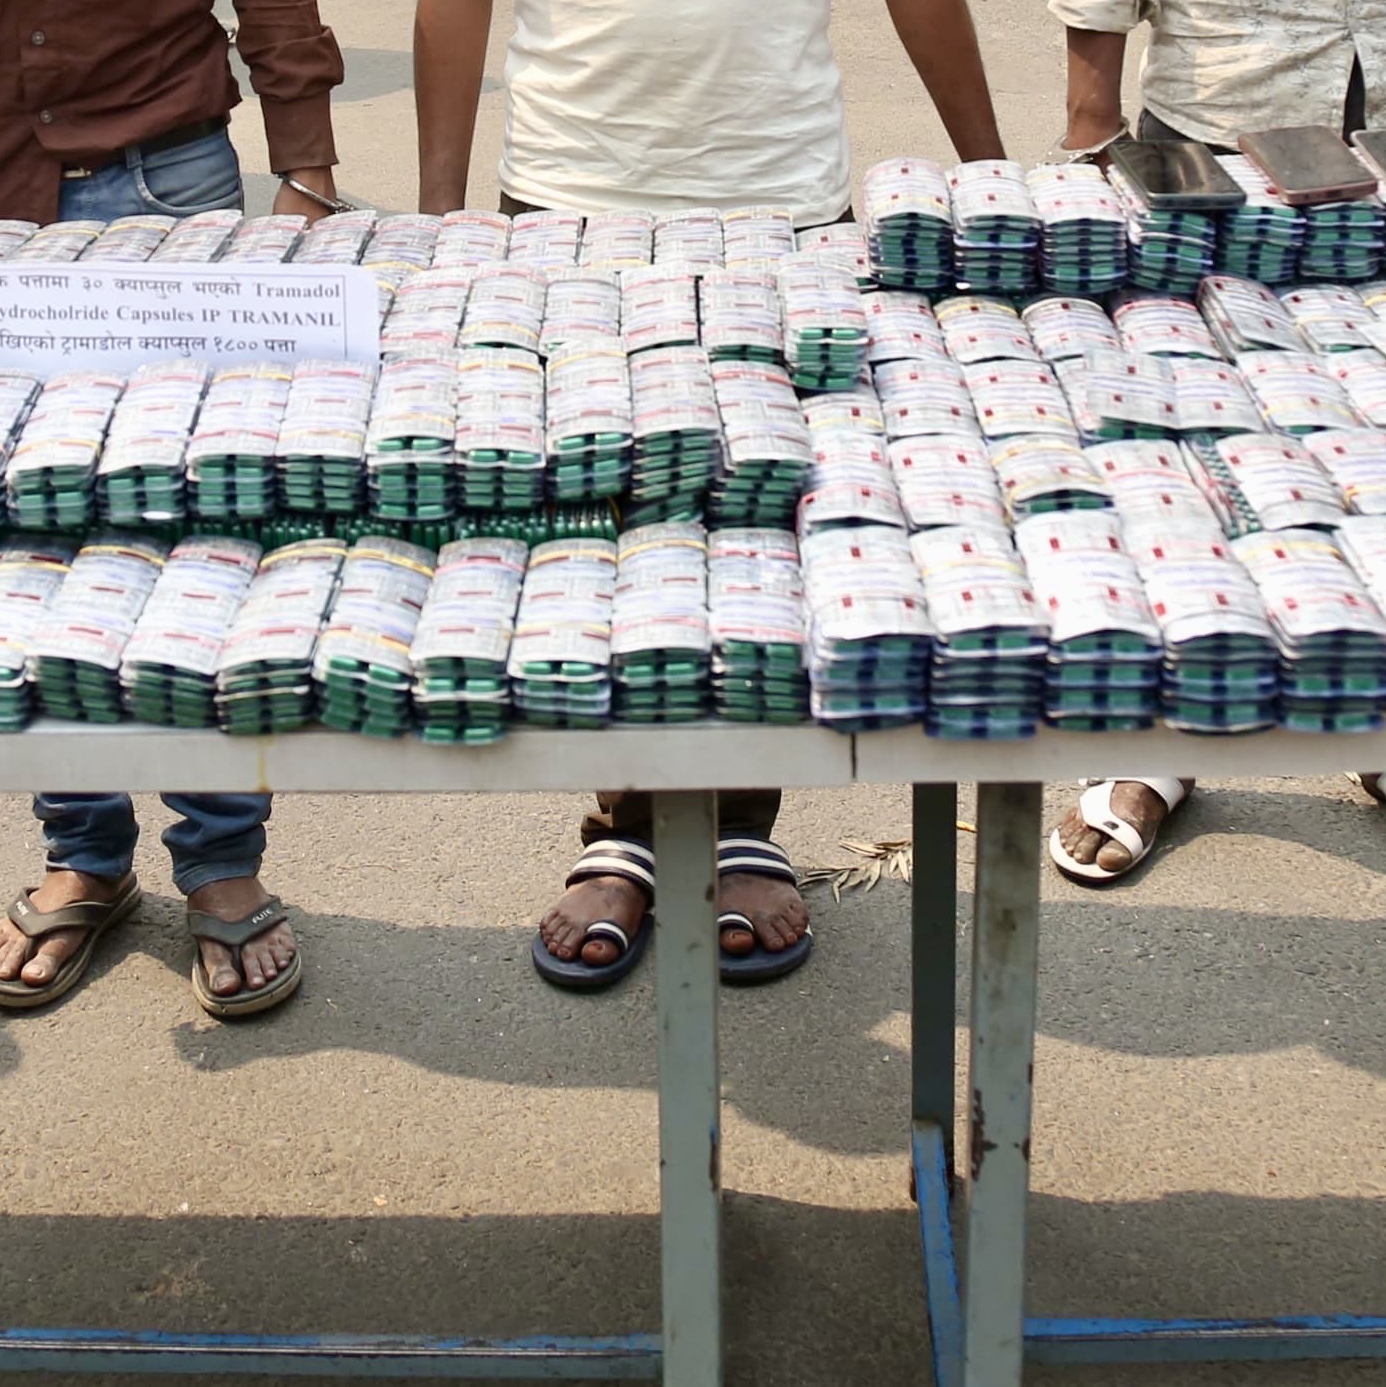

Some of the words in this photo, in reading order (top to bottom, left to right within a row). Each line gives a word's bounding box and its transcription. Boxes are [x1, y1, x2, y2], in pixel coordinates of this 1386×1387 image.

[19, 275, 69, 290] पत्तामा
[82, 276, 103, 290] ३०
[193, 275, 241, 299] भएको
[253, 283, 340, 298] Tramadol
[117, 305, 194, 325] Capsules
[201, 309, 221, 323] IP
[227, 309, 341, 327] TRAMANIL
